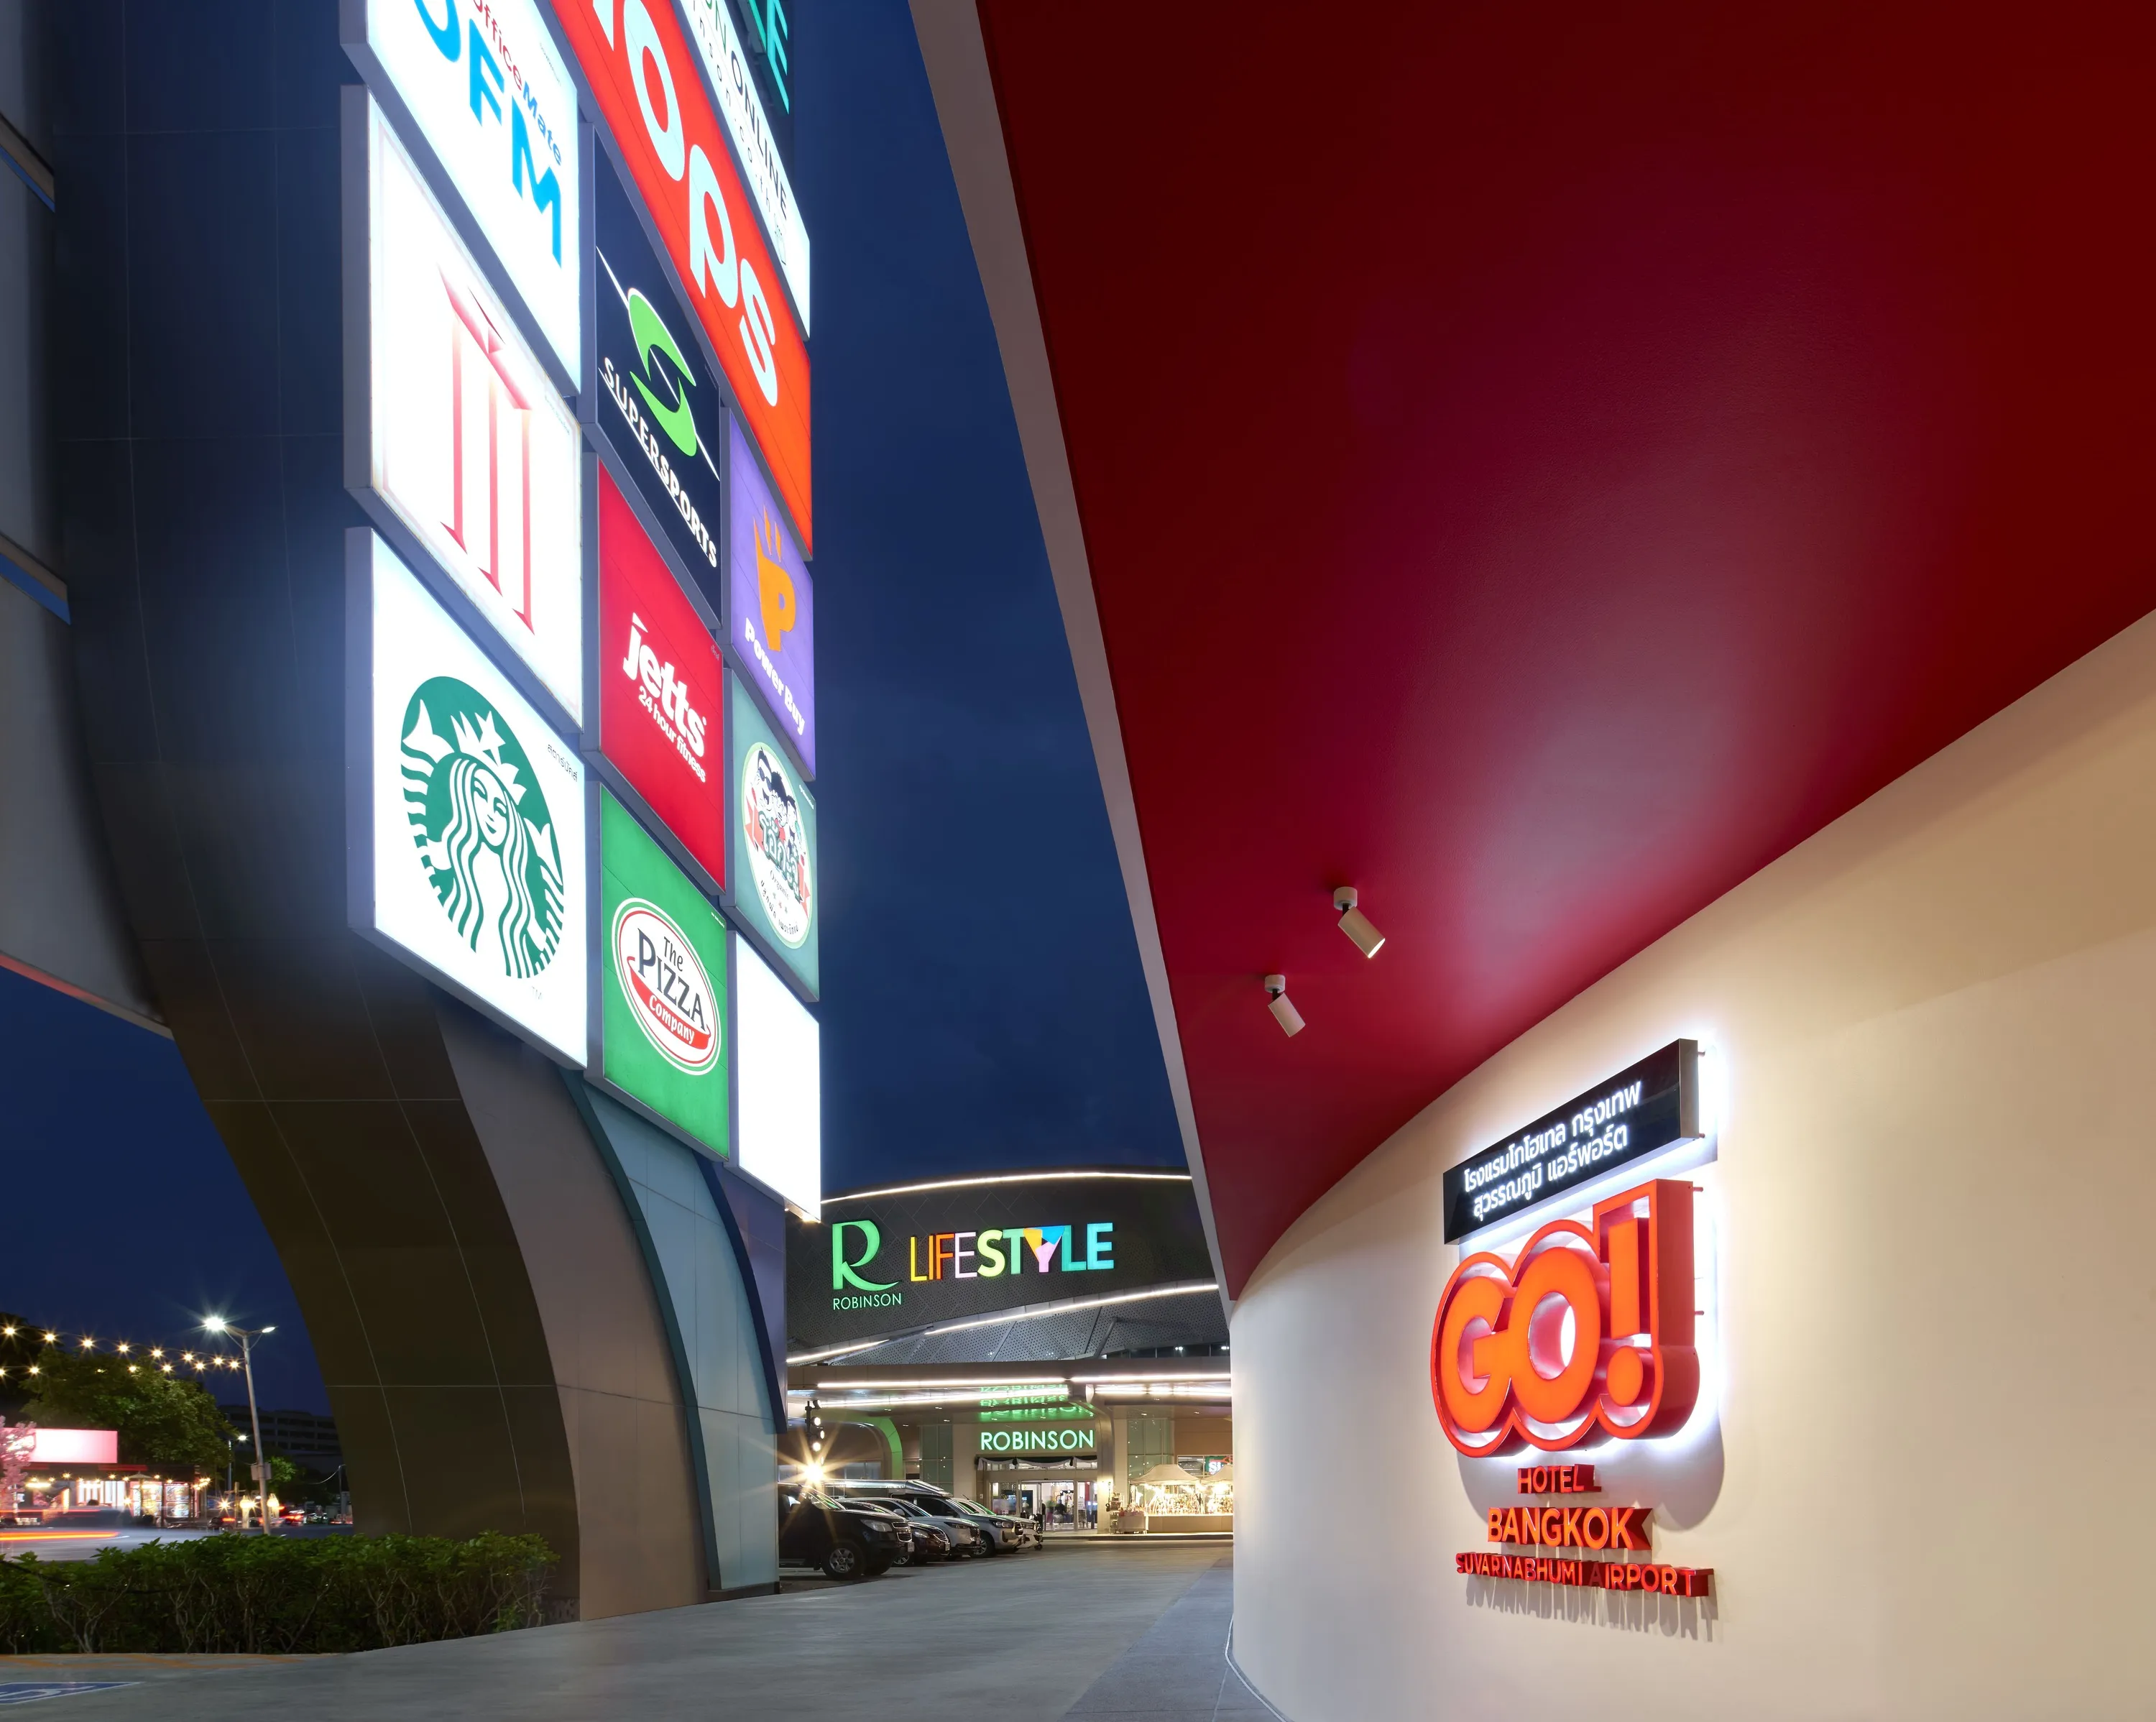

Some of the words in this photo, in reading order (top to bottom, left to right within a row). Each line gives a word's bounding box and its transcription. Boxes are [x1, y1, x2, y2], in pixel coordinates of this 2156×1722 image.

[731, 50, 787, 221] ONLINE
[604, 356, 717, 568] SUPERSPORTS
[622, 612, 706, 758] jetts
[638, 685, 653, 714] 24
[653, 703, 678, 743] hour
[676, 735, 706, 783] fitness
[770, 870, 790, 901] Organic
[637, 927, 706, 1032] PIZZA
[663, 936, 683, 972] The
[649, 994, 696, 1045] Company
[1463, 1123, 1567, 1193] โรงแรมโกโฮเทล
[1571, 1081, 1642, 1137] กรุงเทพ
[1473, 1162, 1542, 1222] สุวรรณภูมิ
[1547, 1123, 1628, 1182] แอร์พอร์ต
[909, 1222, 1115, 1282] LIFESTYLE
[832, 1292, 903, 1311] ROBINSON
[1437, 1215, 1647, 1437] GO!
[980, 1429, 1095, 1452] ROBINSON
[1517, 1464, 1585, 1494] HOTEL
[1487, 1506, 1635, 1550] BANGKOK
[1455, 1552, 1583, 1587] SUVARNABHUMI
[1589, 1562, 1697, 1597] AIRPORT
